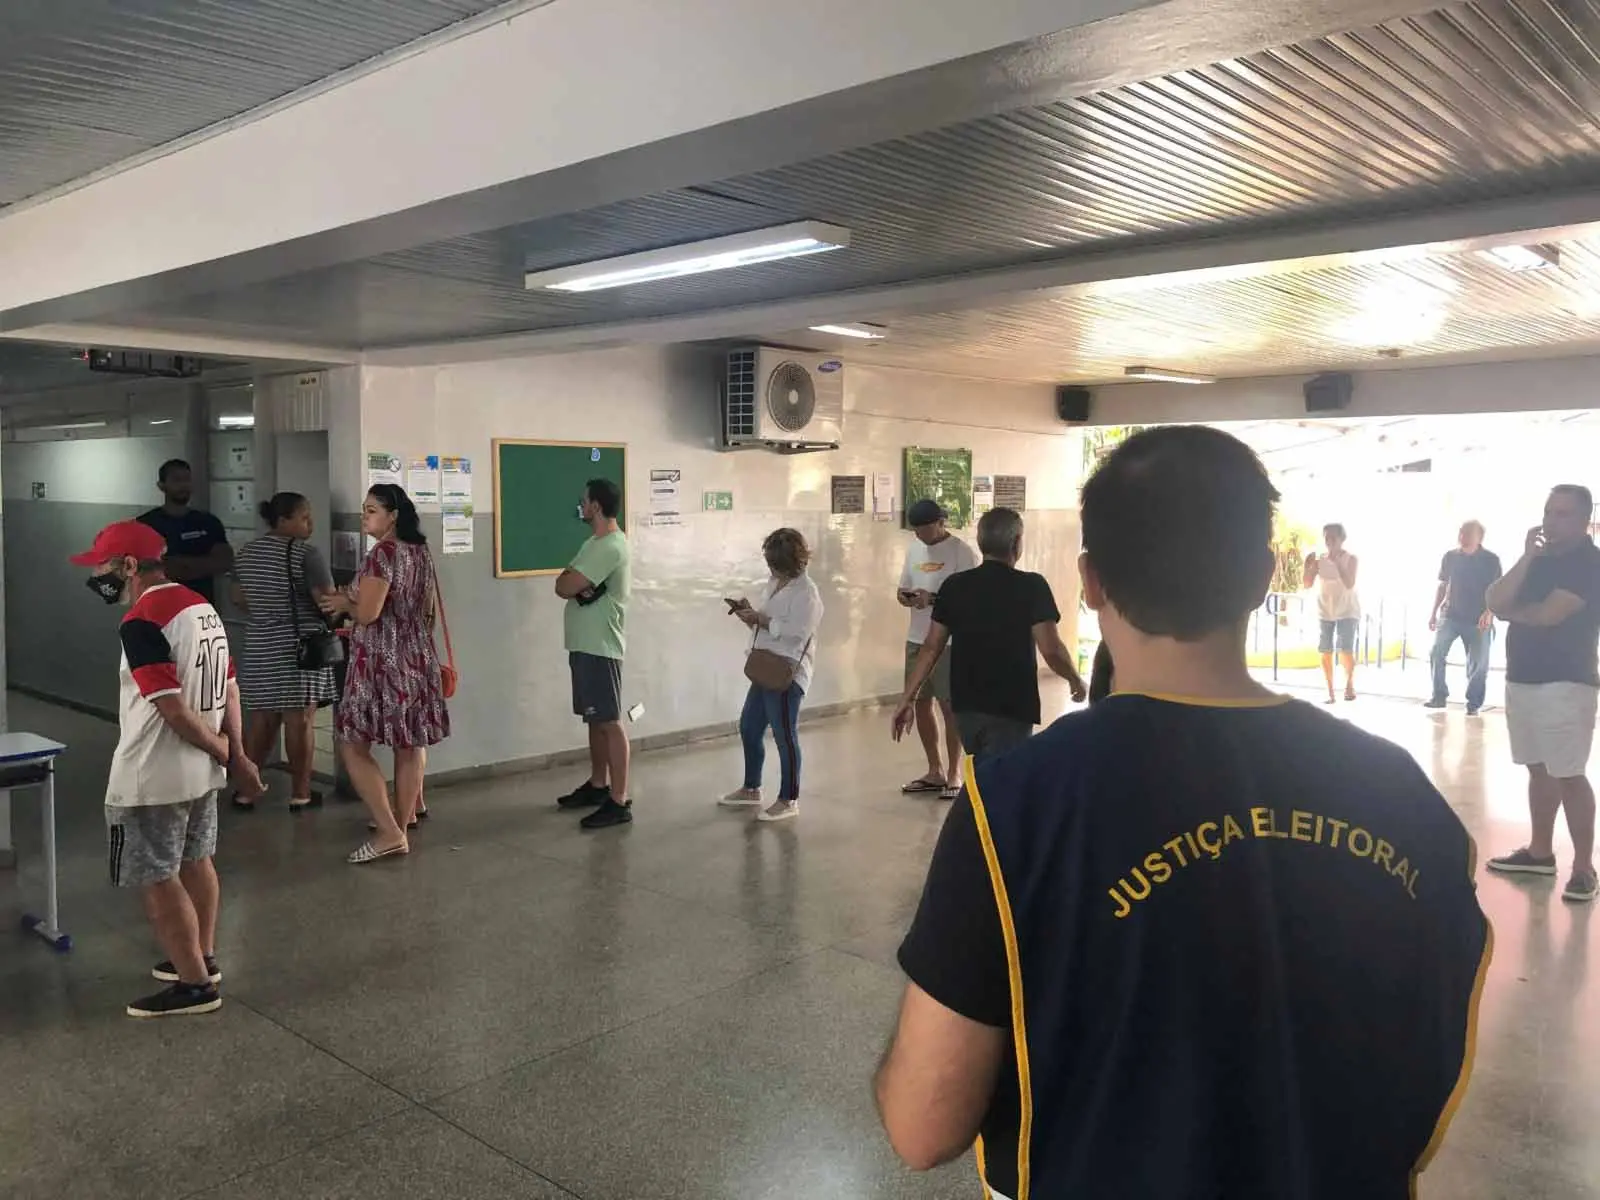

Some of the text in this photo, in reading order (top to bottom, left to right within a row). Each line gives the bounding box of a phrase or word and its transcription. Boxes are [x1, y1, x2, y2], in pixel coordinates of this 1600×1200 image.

[195, 635, 227, 711] 10
[1108, 807, 1420, 918] JUSTIÇA ELEITORAL
